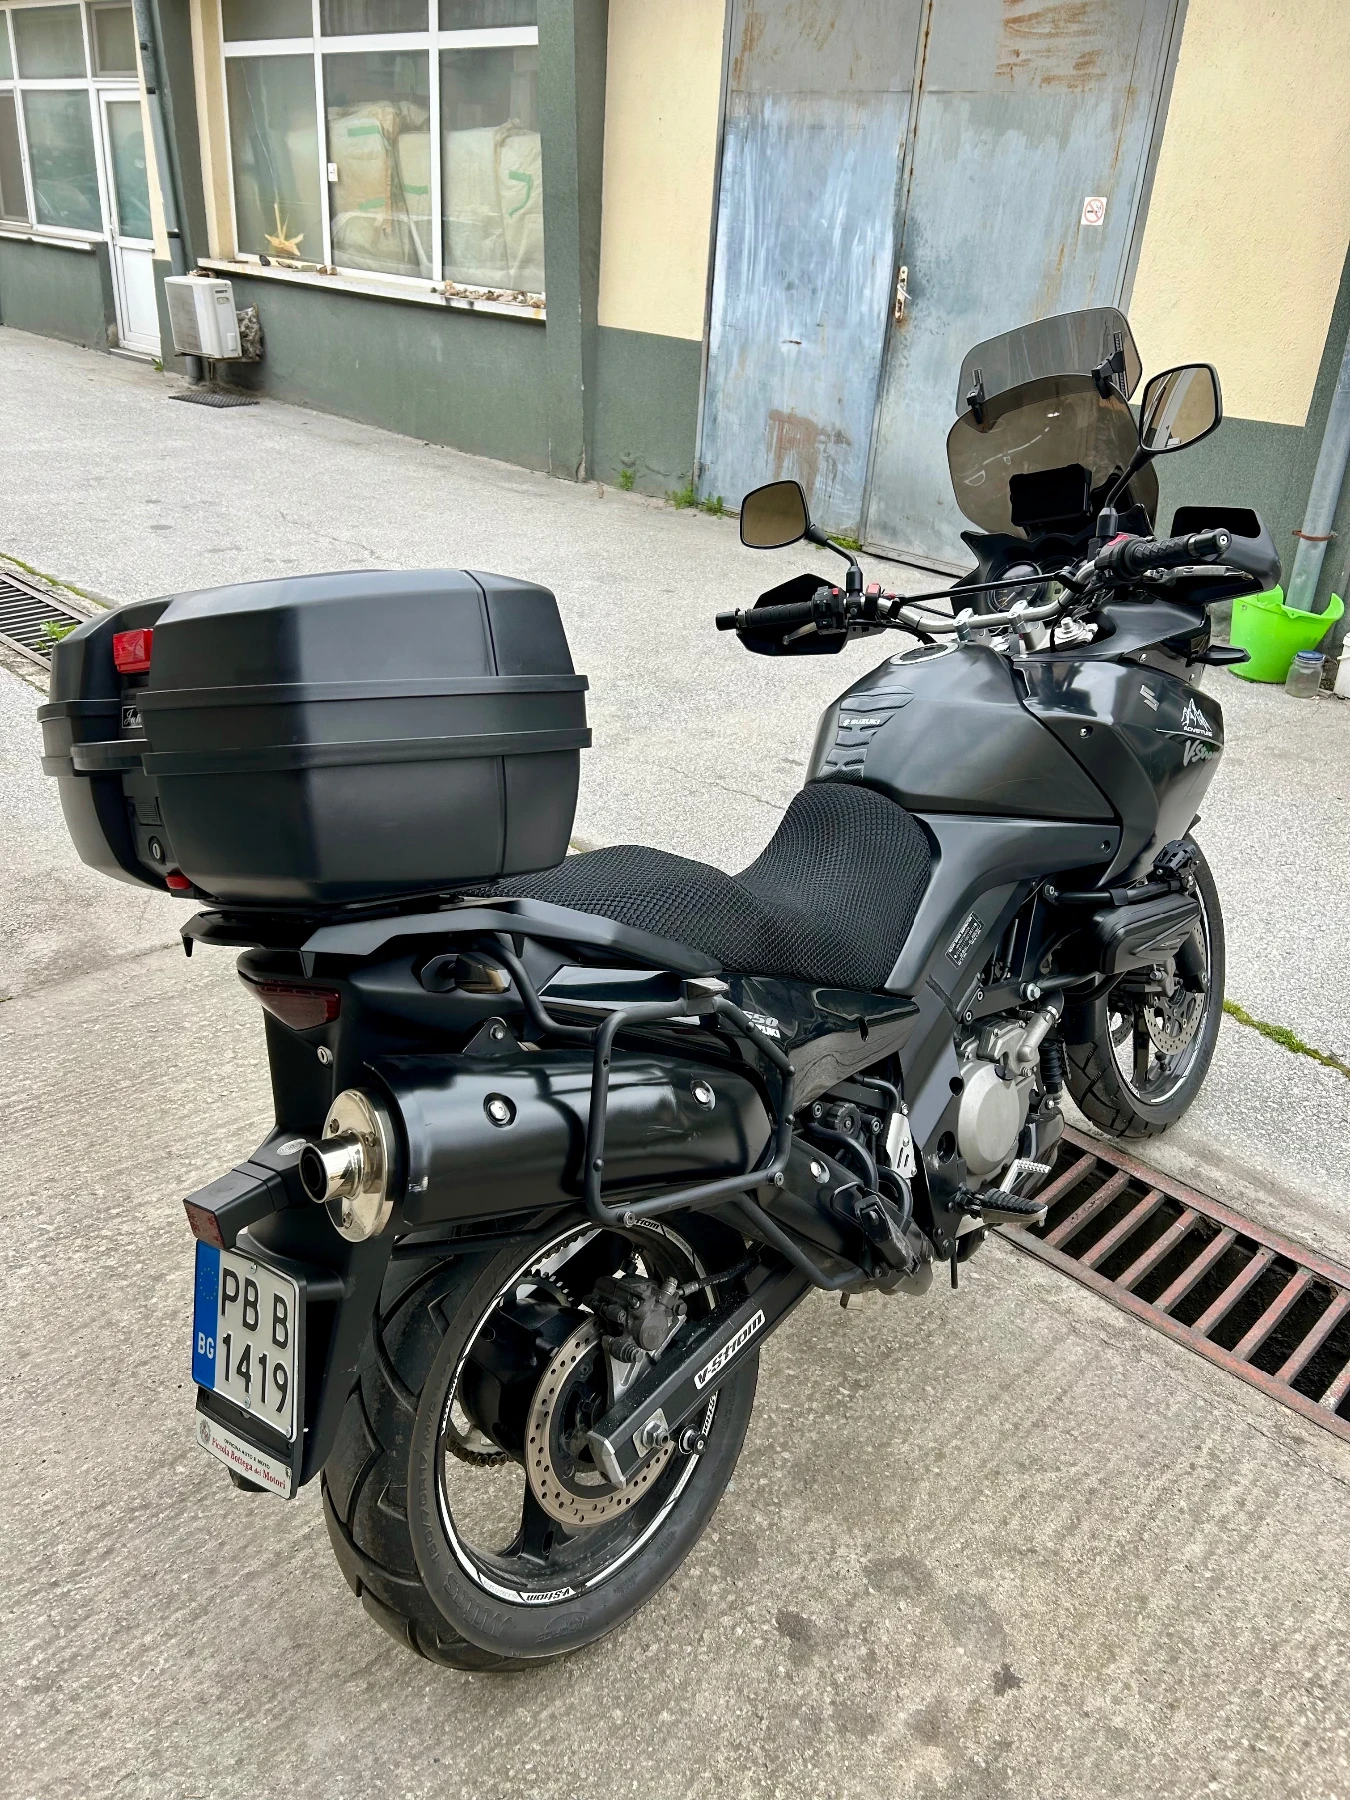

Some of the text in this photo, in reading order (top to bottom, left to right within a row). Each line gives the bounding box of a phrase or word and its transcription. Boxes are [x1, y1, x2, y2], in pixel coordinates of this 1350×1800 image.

[197, 1331, 214, 1360] BG
[697, 1313, 763, 1385] V-Strom
[222, 1332, 290, 1414] 1419
[230, 1449, 253, 1472] Bottega
[253, 1466, 262, 1476] dei
[262, 1469, 286, 1489] Motori
[242, 1450, 253, 1460] AUTO
[257, 1459, 271, 1469] MOTO
[525, 1588, 571, 1602] V-Strom
